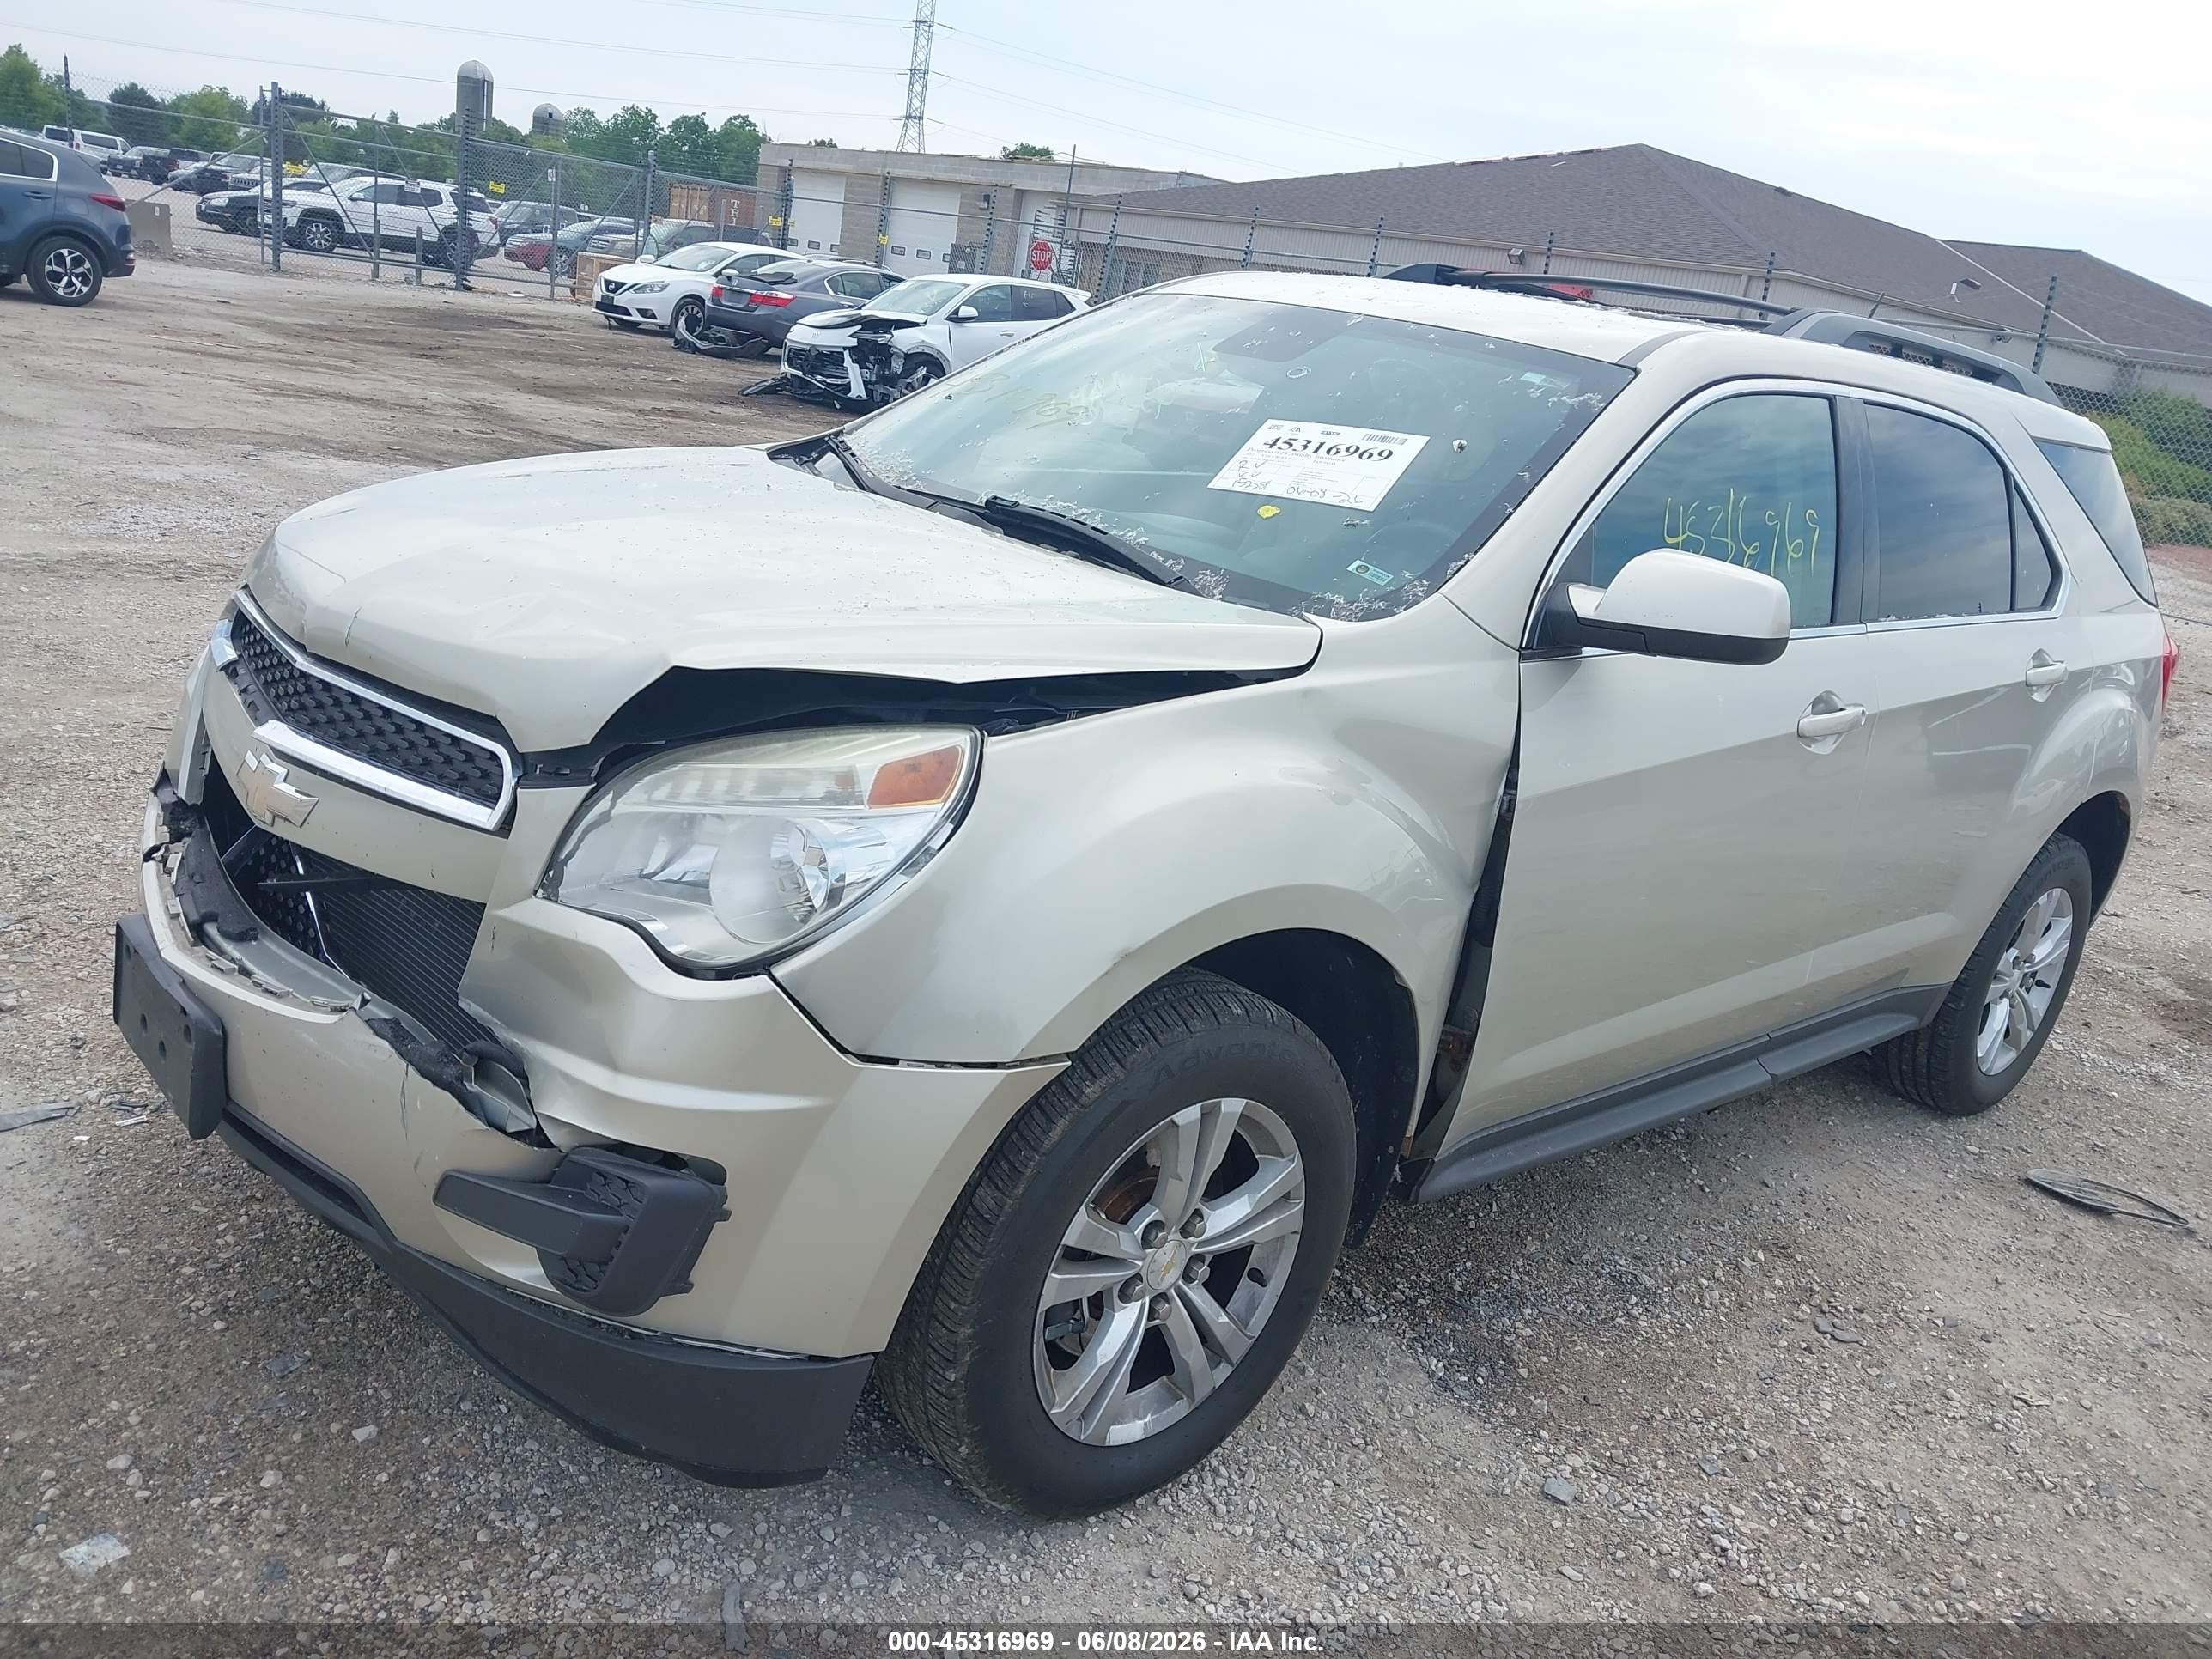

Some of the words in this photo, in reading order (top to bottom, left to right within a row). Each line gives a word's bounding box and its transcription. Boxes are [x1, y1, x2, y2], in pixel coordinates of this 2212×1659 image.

[1031, 250, 1052, 262] STOP
[1263, 435, 1394, 462] 45316969
[1662, 487, 1820, 578] 45316969
